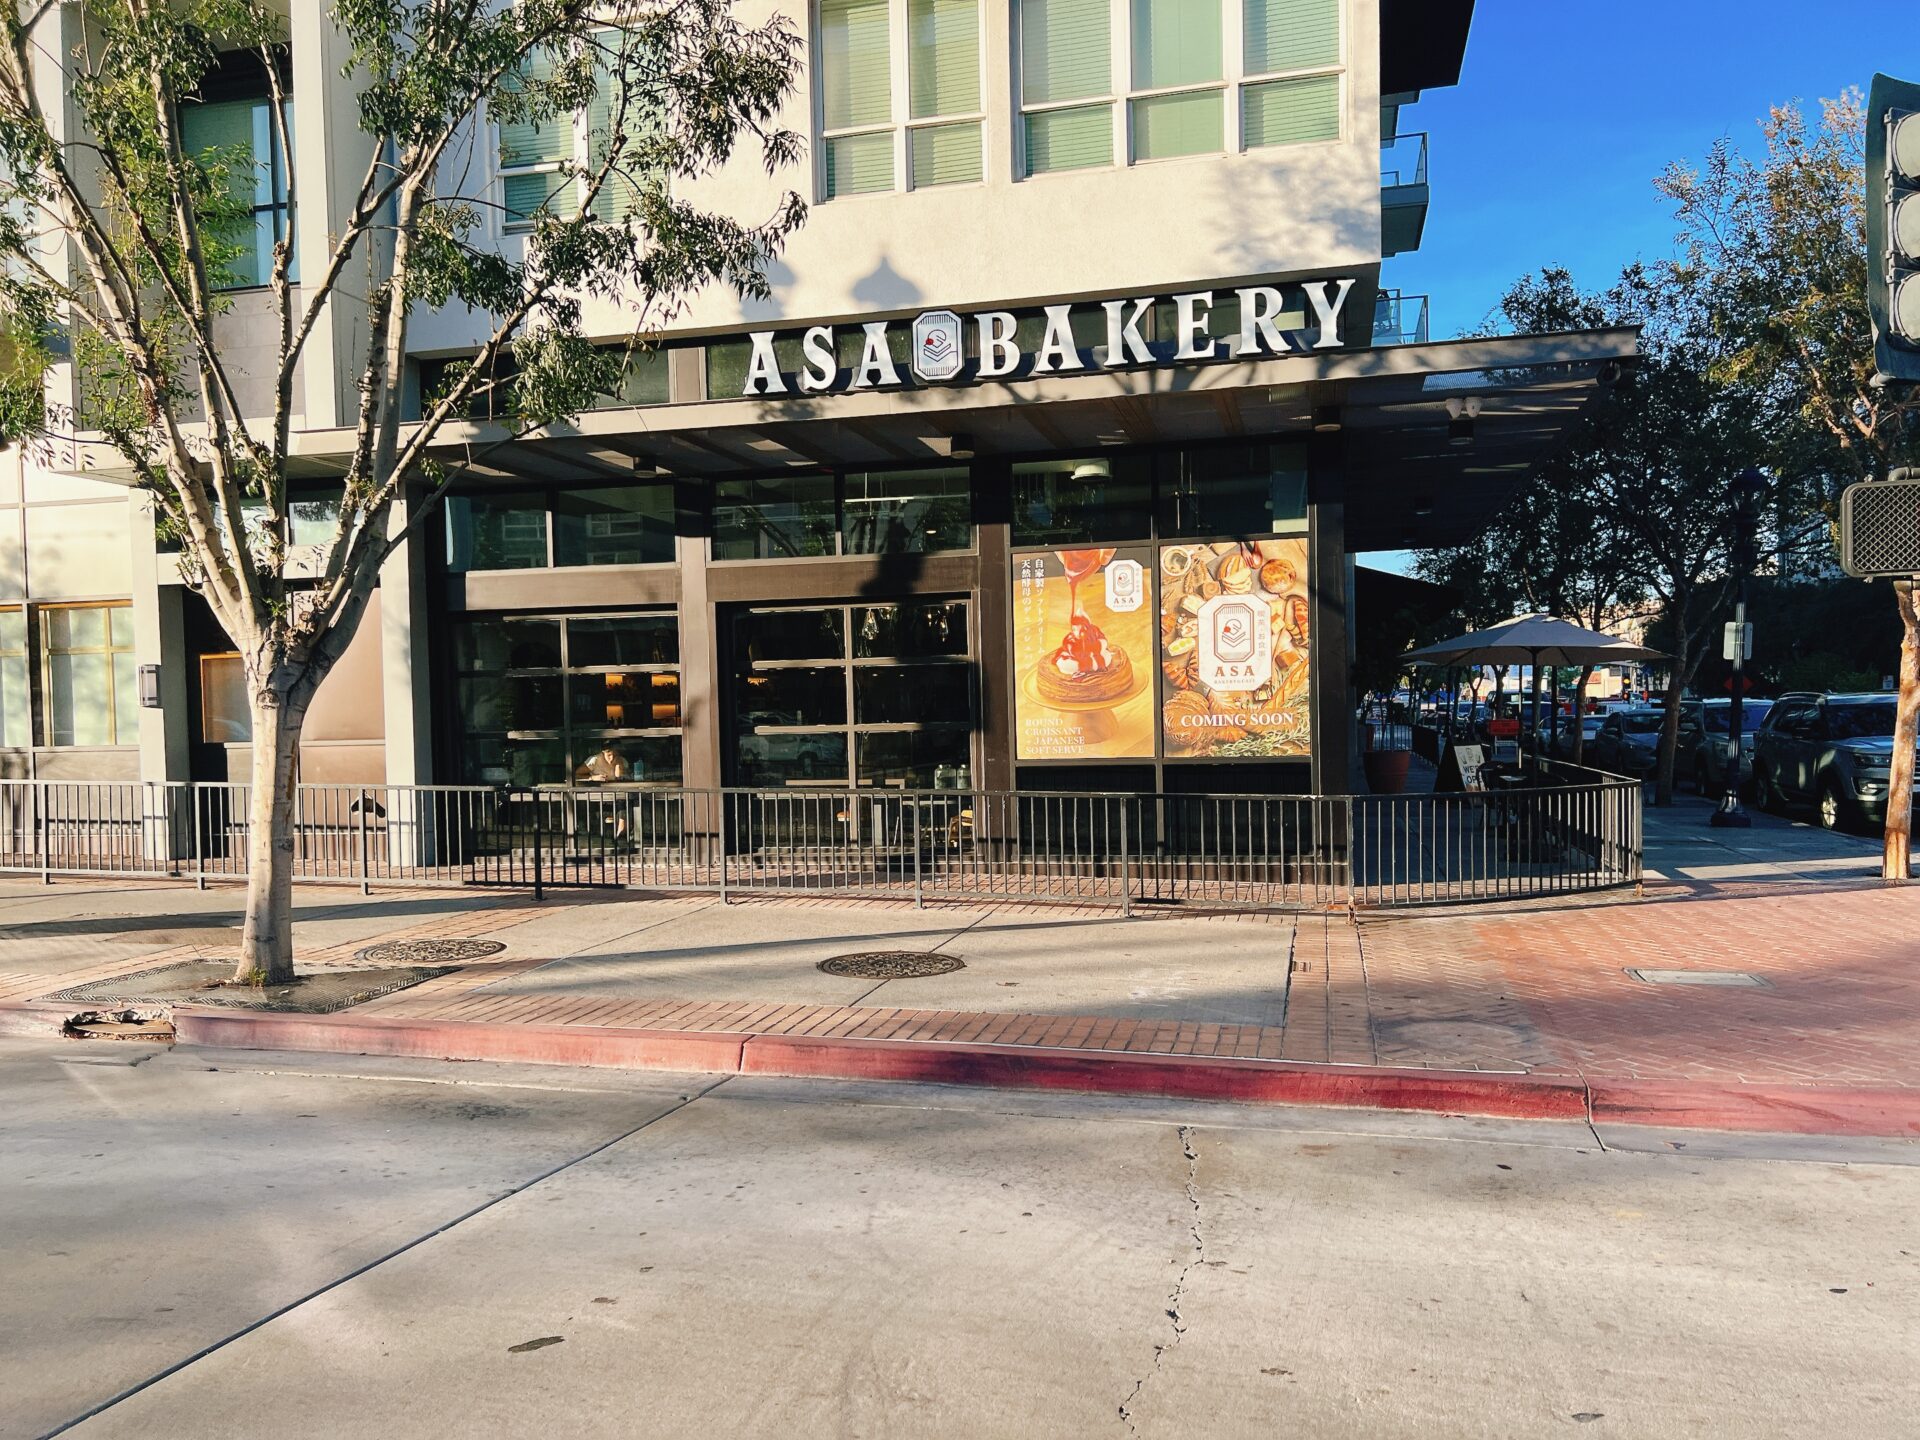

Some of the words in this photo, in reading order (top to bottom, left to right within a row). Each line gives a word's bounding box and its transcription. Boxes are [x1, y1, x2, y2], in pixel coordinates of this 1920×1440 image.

[743, 321, 902, 396] ASA
[973, 278, 1356, 377] BAKERY
[1215, 665, 1254, 677] ASA
[1025, 718, 1063, 727] ROUND
[1181, 714, 1247, 727] COMING
[1250, 712, 1293, 725] SOON
[1025, 727, 1083, 736] CROISSANT
[1034, 736, 1085, 745] JAPANESE
[1025, 745, 1049, 754] SOFT
[1050, 745, 1085, 754] SERVE
